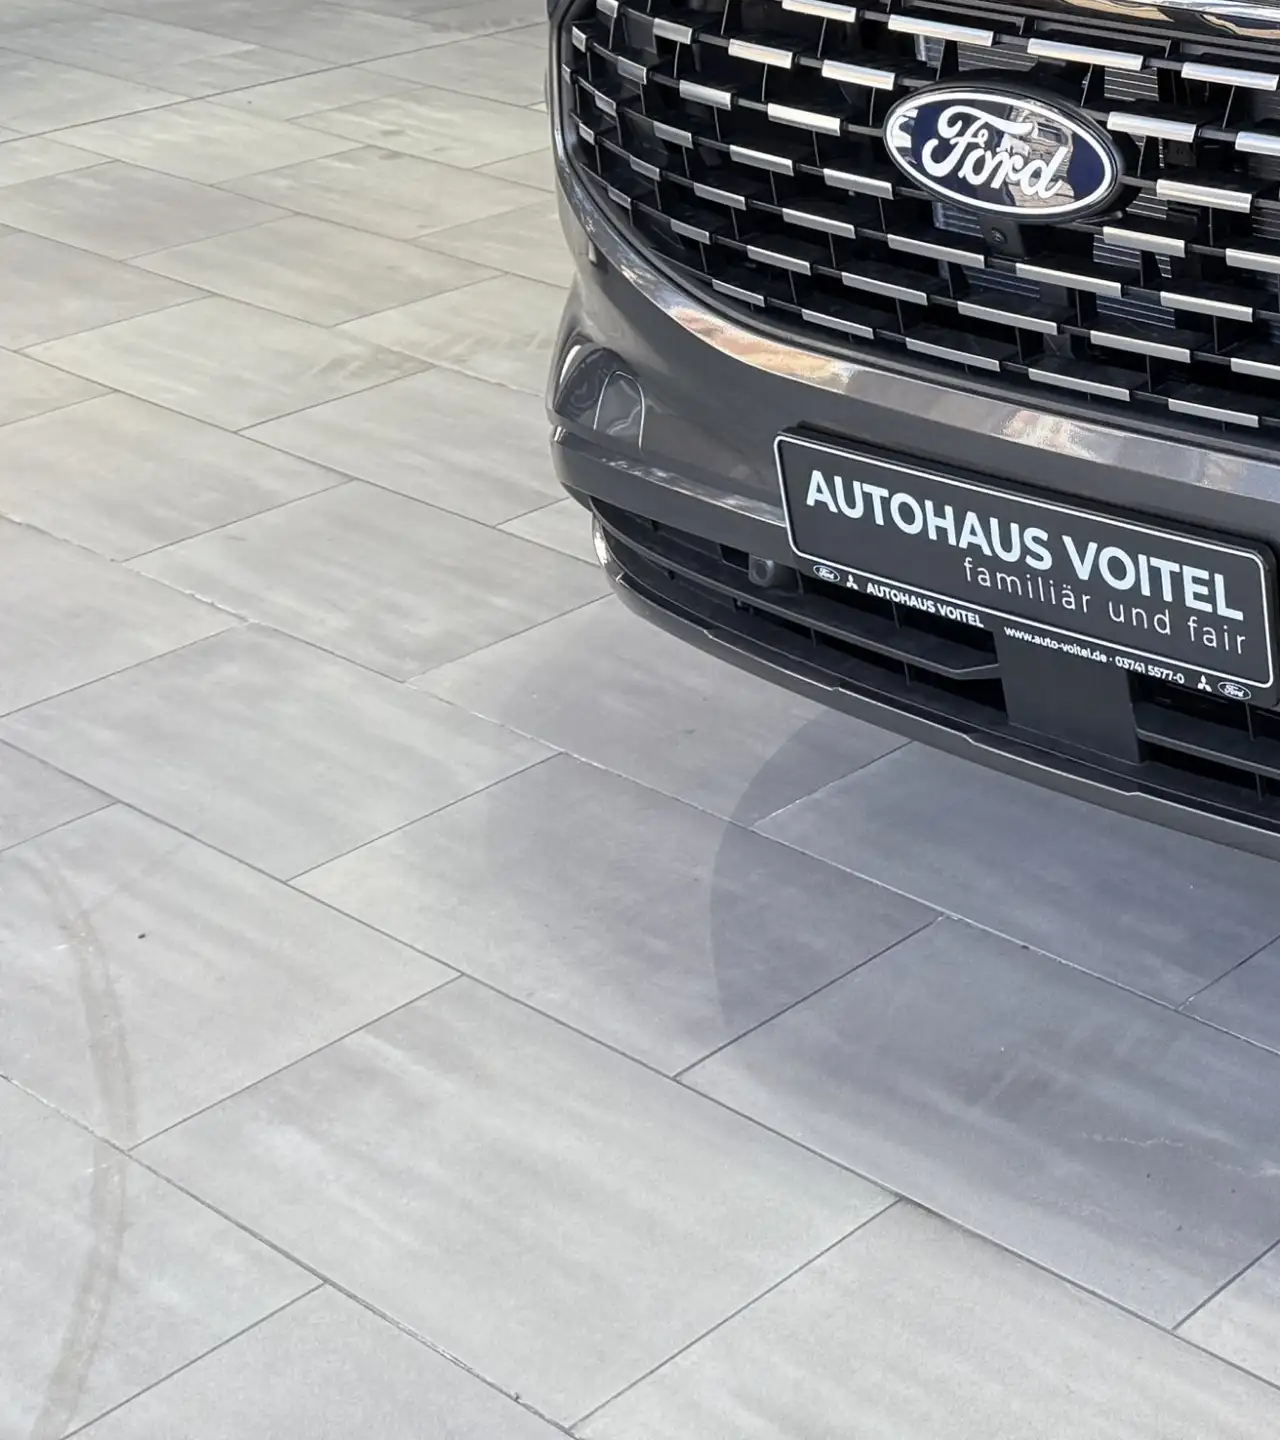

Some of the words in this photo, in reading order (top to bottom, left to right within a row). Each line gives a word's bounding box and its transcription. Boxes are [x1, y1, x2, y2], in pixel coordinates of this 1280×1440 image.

[921, 105, 1068, 200] Ford
[806, 469, 1052, 571] AUTOHAUS
[1062, 535, 1244, 620] VOITEL
[867, 582, 935, 614] AUTOHAUS
[937, 603, 984, 628] VOITEL
[964, 557, 1091, 614] familiär
[1109, 602, 1171, 635] und
[1187, 616, 1245, 655] fair
[1004, 626, 1107, 663] www.auto-voitel.de
[1115, 655, 1146, 674] 03741
[1148, 664, 1185, 684] 5577-0
